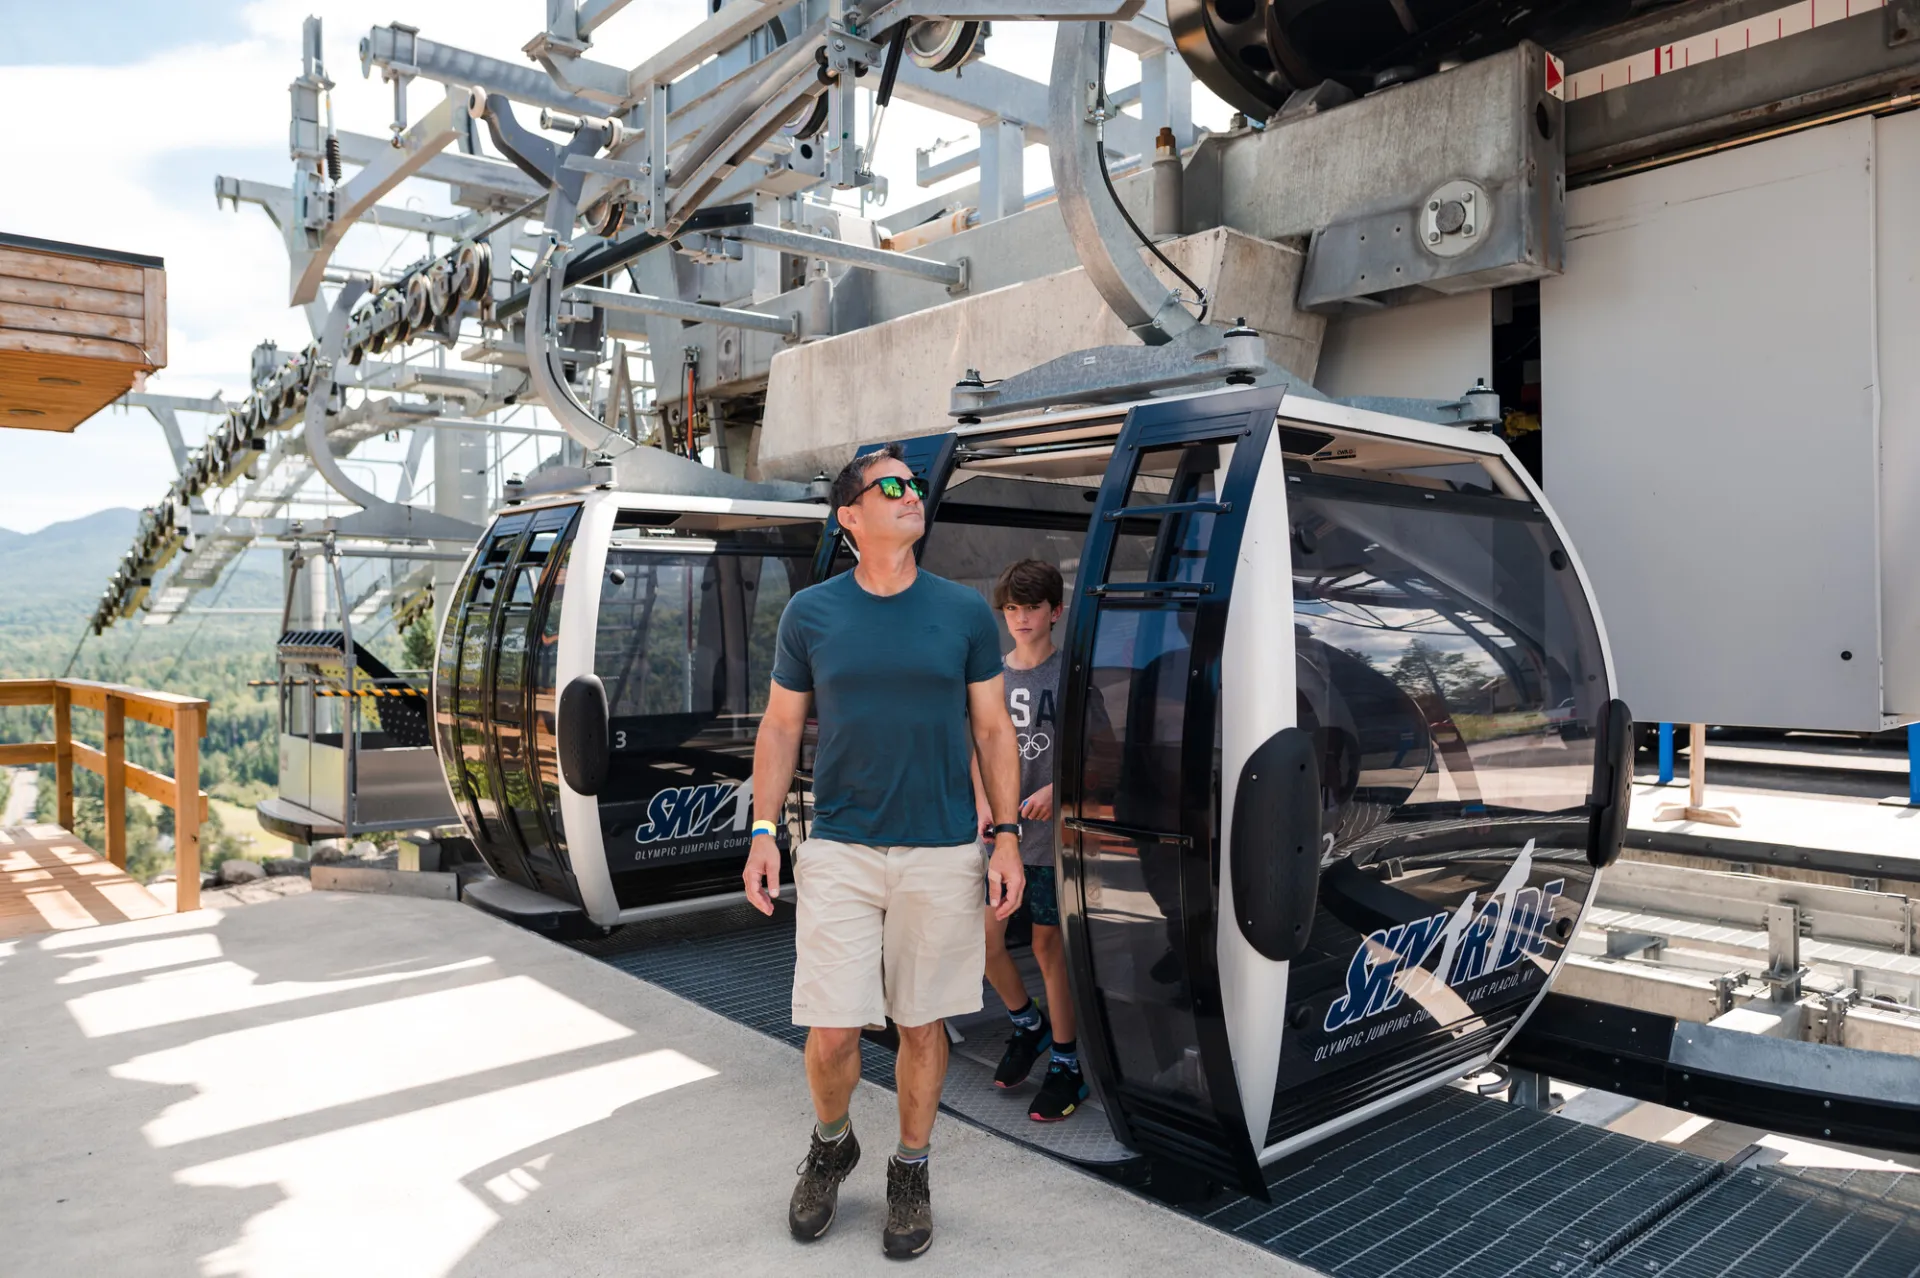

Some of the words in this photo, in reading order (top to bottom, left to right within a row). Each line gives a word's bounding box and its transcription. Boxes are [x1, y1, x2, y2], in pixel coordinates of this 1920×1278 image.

[1664, 45, 1673, 69] 1
[1010, 687, 1056, 728] SA
[615, 731, 627, 749] 3
[635, 846, 677, 860] OLYMPIC
[680, 841, 720, 855] JUMPING
[723, 836, 752, 849] COMPL
[1320, 832, 1335, 866] 2
[1314, 1031, 1363, 1062] OLYMPIC
[1365, 1013, 1412, 1043] JUMPING
[1465, 983, 1486, 1005] LAKE
[1521, 968, 1535, 983] NY
